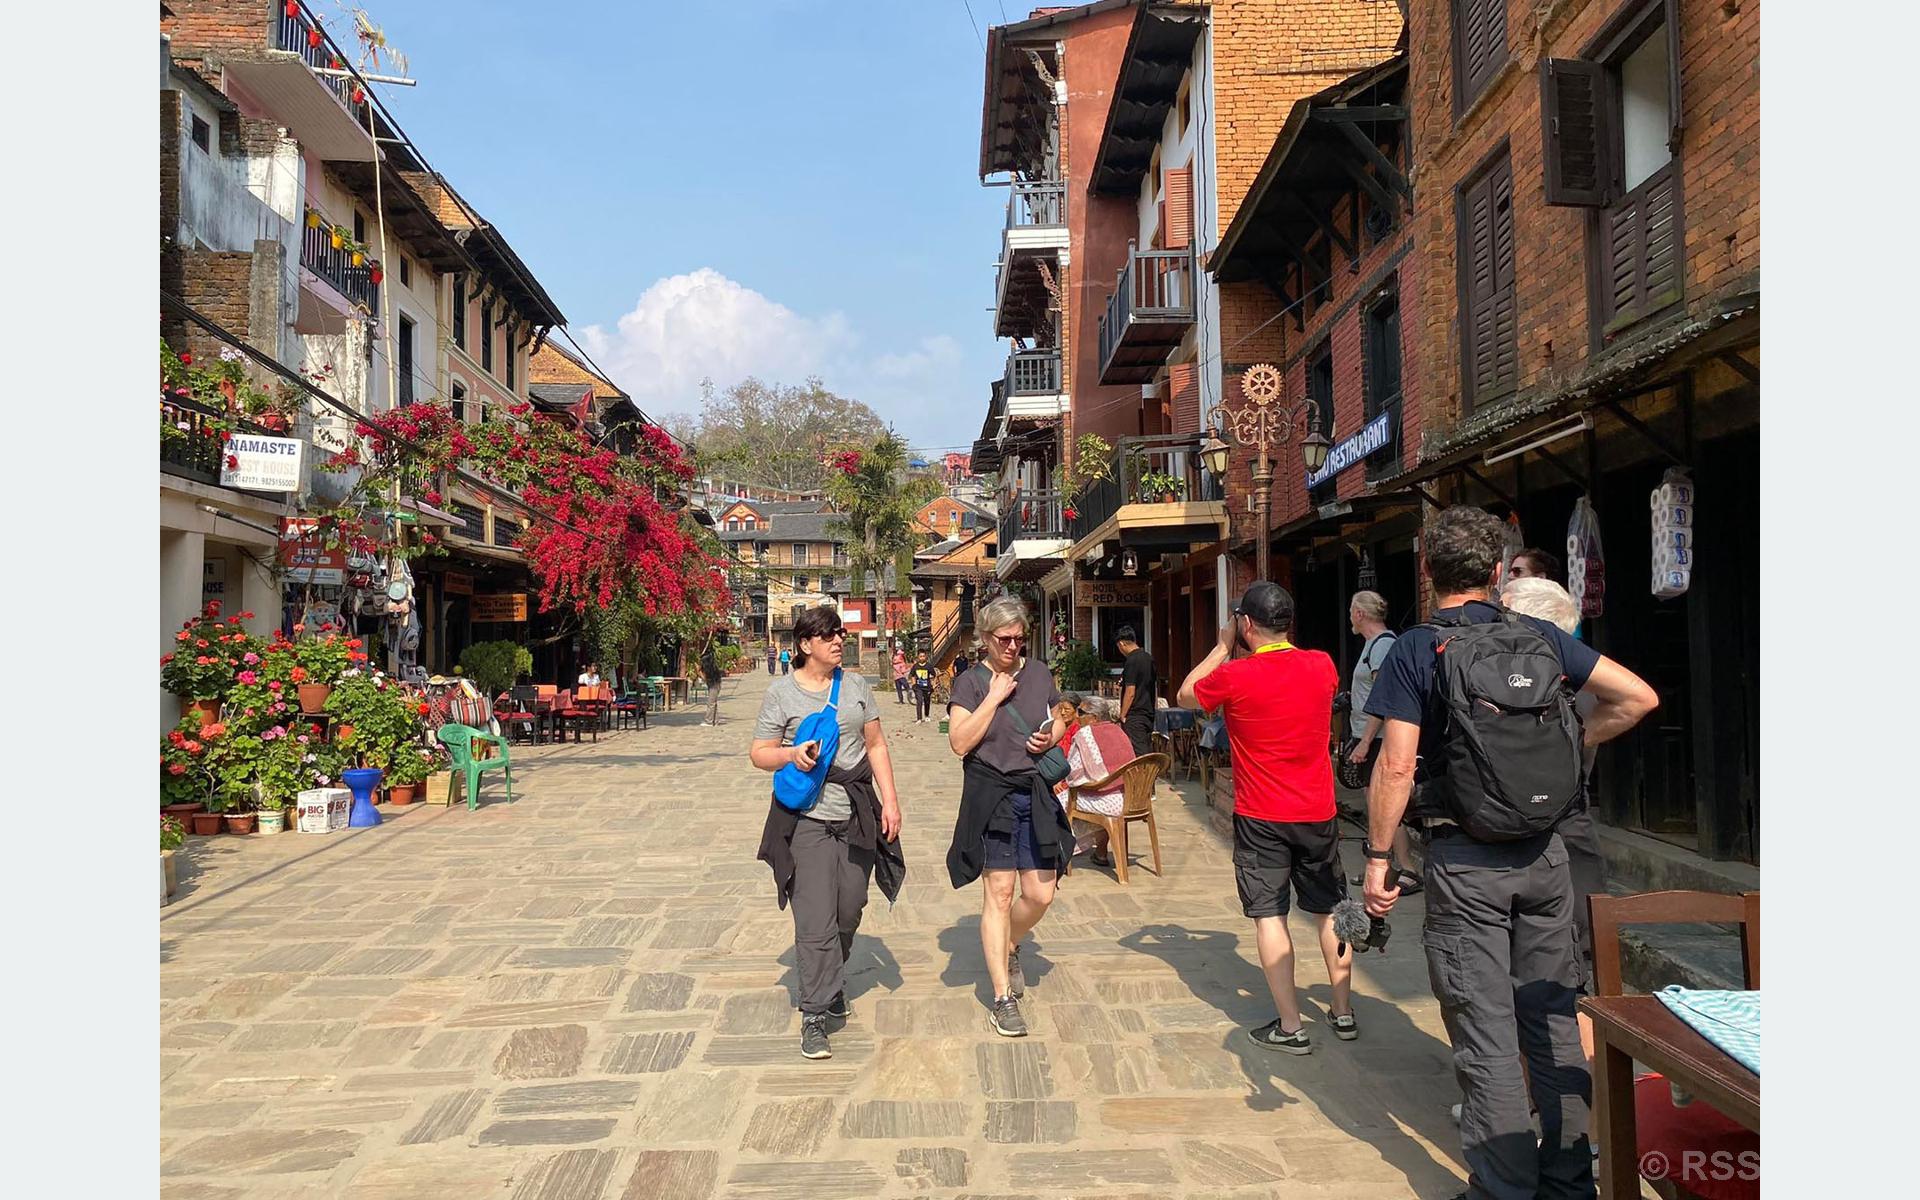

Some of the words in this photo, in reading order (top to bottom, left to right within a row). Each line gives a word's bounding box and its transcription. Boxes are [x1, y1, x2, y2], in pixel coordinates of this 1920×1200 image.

[229, 438, 296, 456] NAMASTE
[263, 460, 297, 477] HOUSE
[1092, 583, 1115, 593] HOTEL
[1092, 594, 1114, 603] RED
[1116, 592, 1149, 604] ROSE
[307, 805, 325, 814] BIG
[336, 800, 347, 811] BIG
